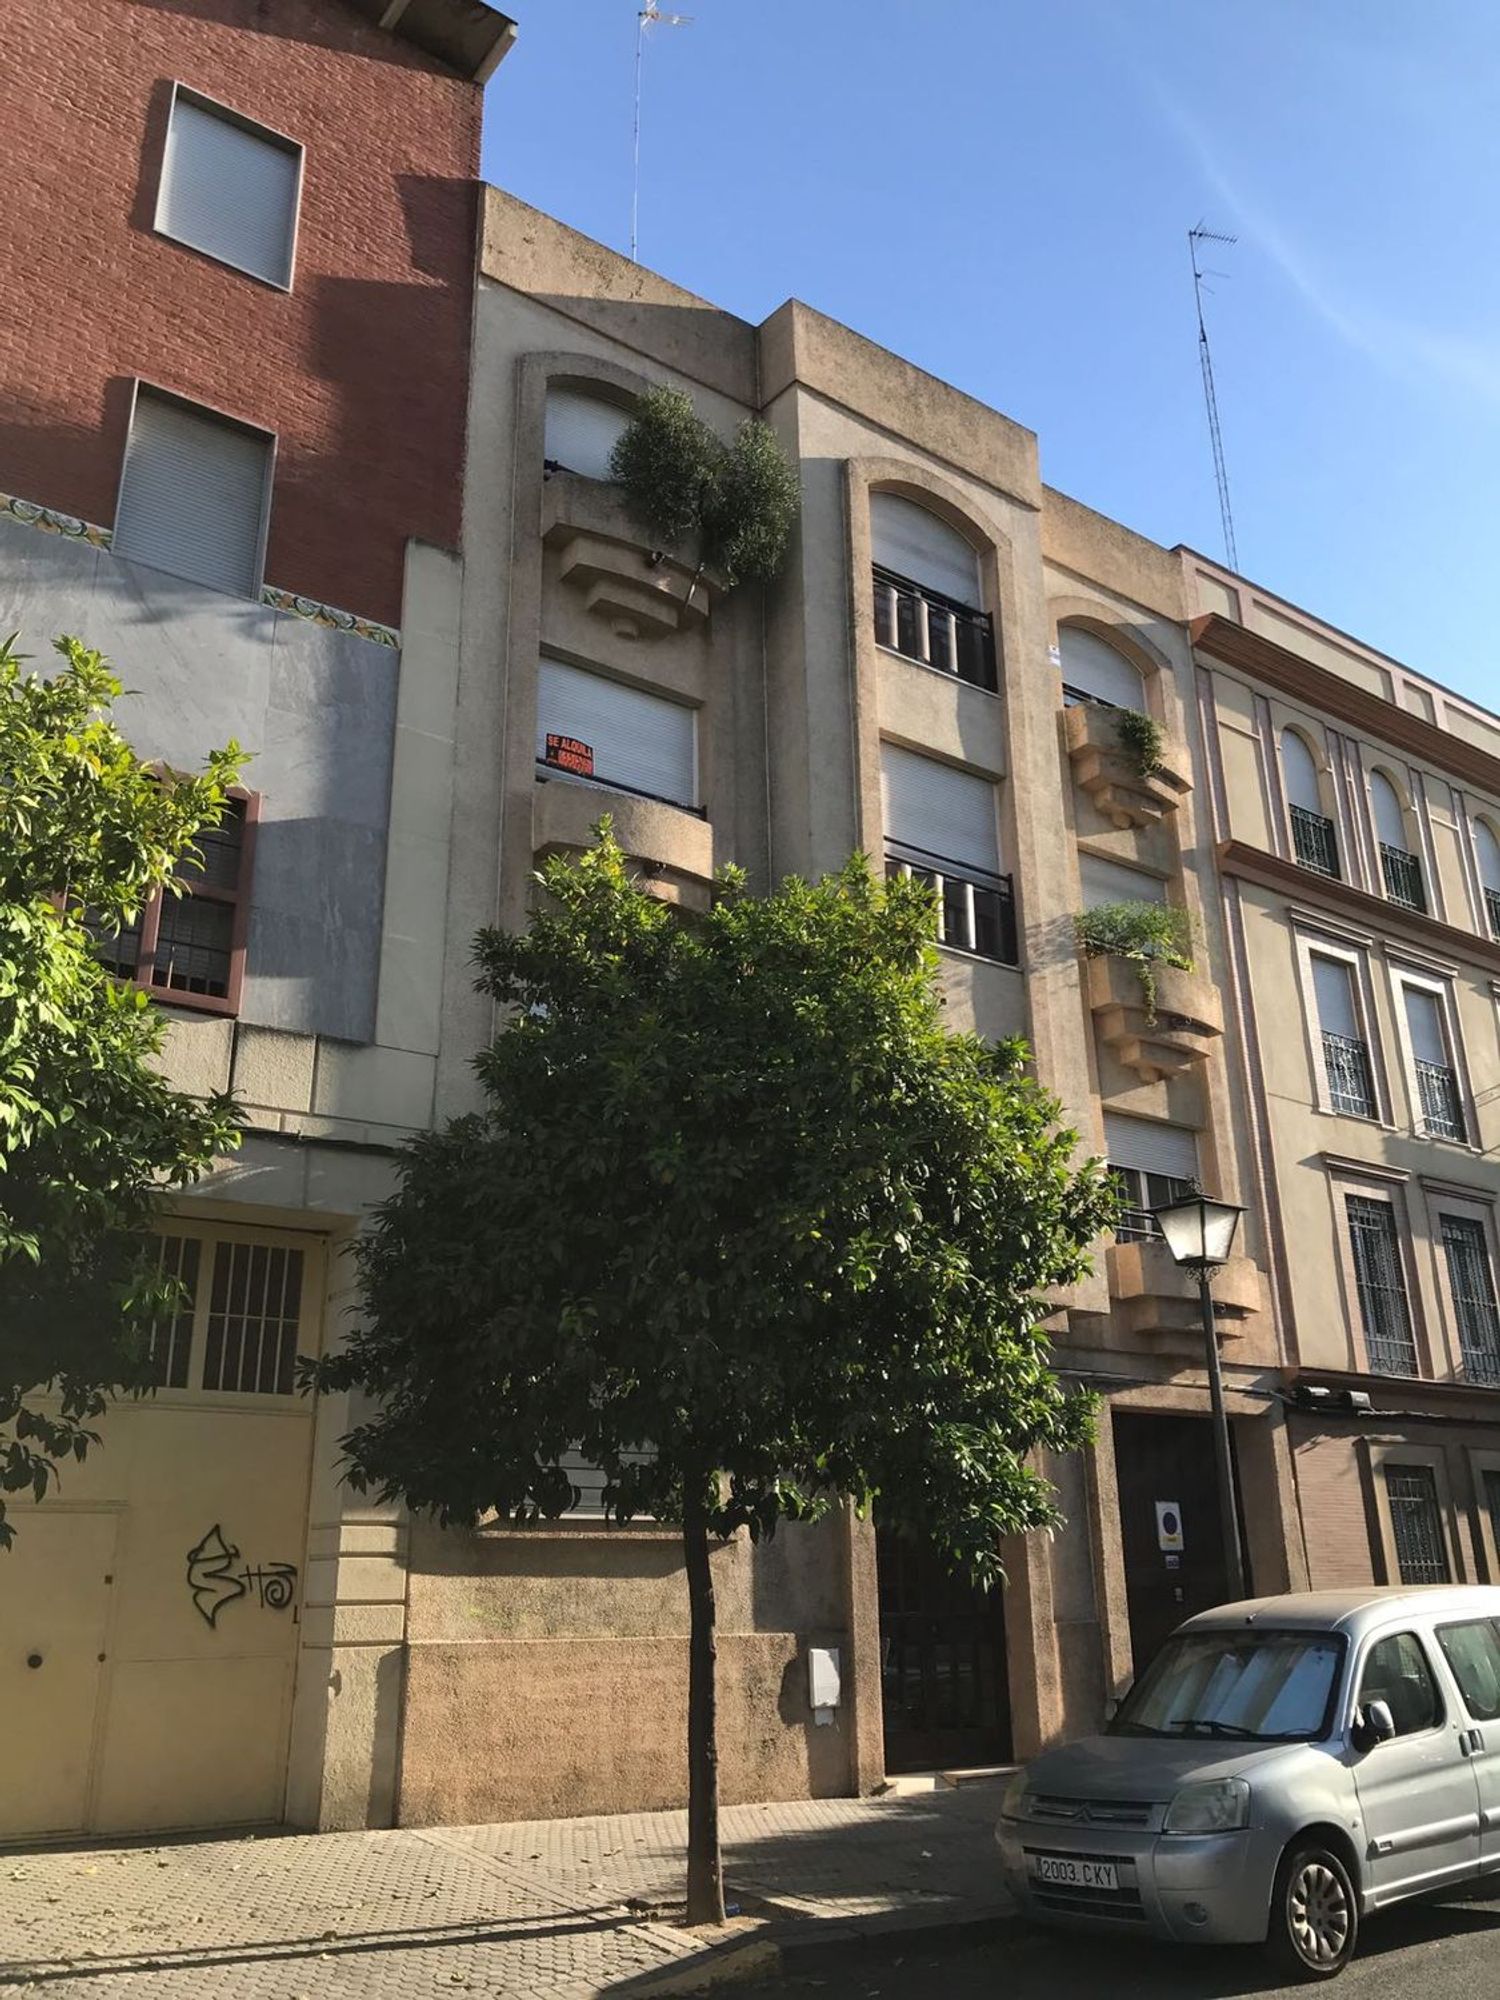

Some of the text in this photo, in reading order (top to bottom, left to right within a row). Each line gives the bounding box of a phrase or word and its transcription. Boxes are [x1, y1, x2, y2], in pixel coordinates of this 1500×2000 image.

[547, 735, 592, 758] SE ALQUILA
[1043, 1860, 1112, 1886] 2003 CKY
